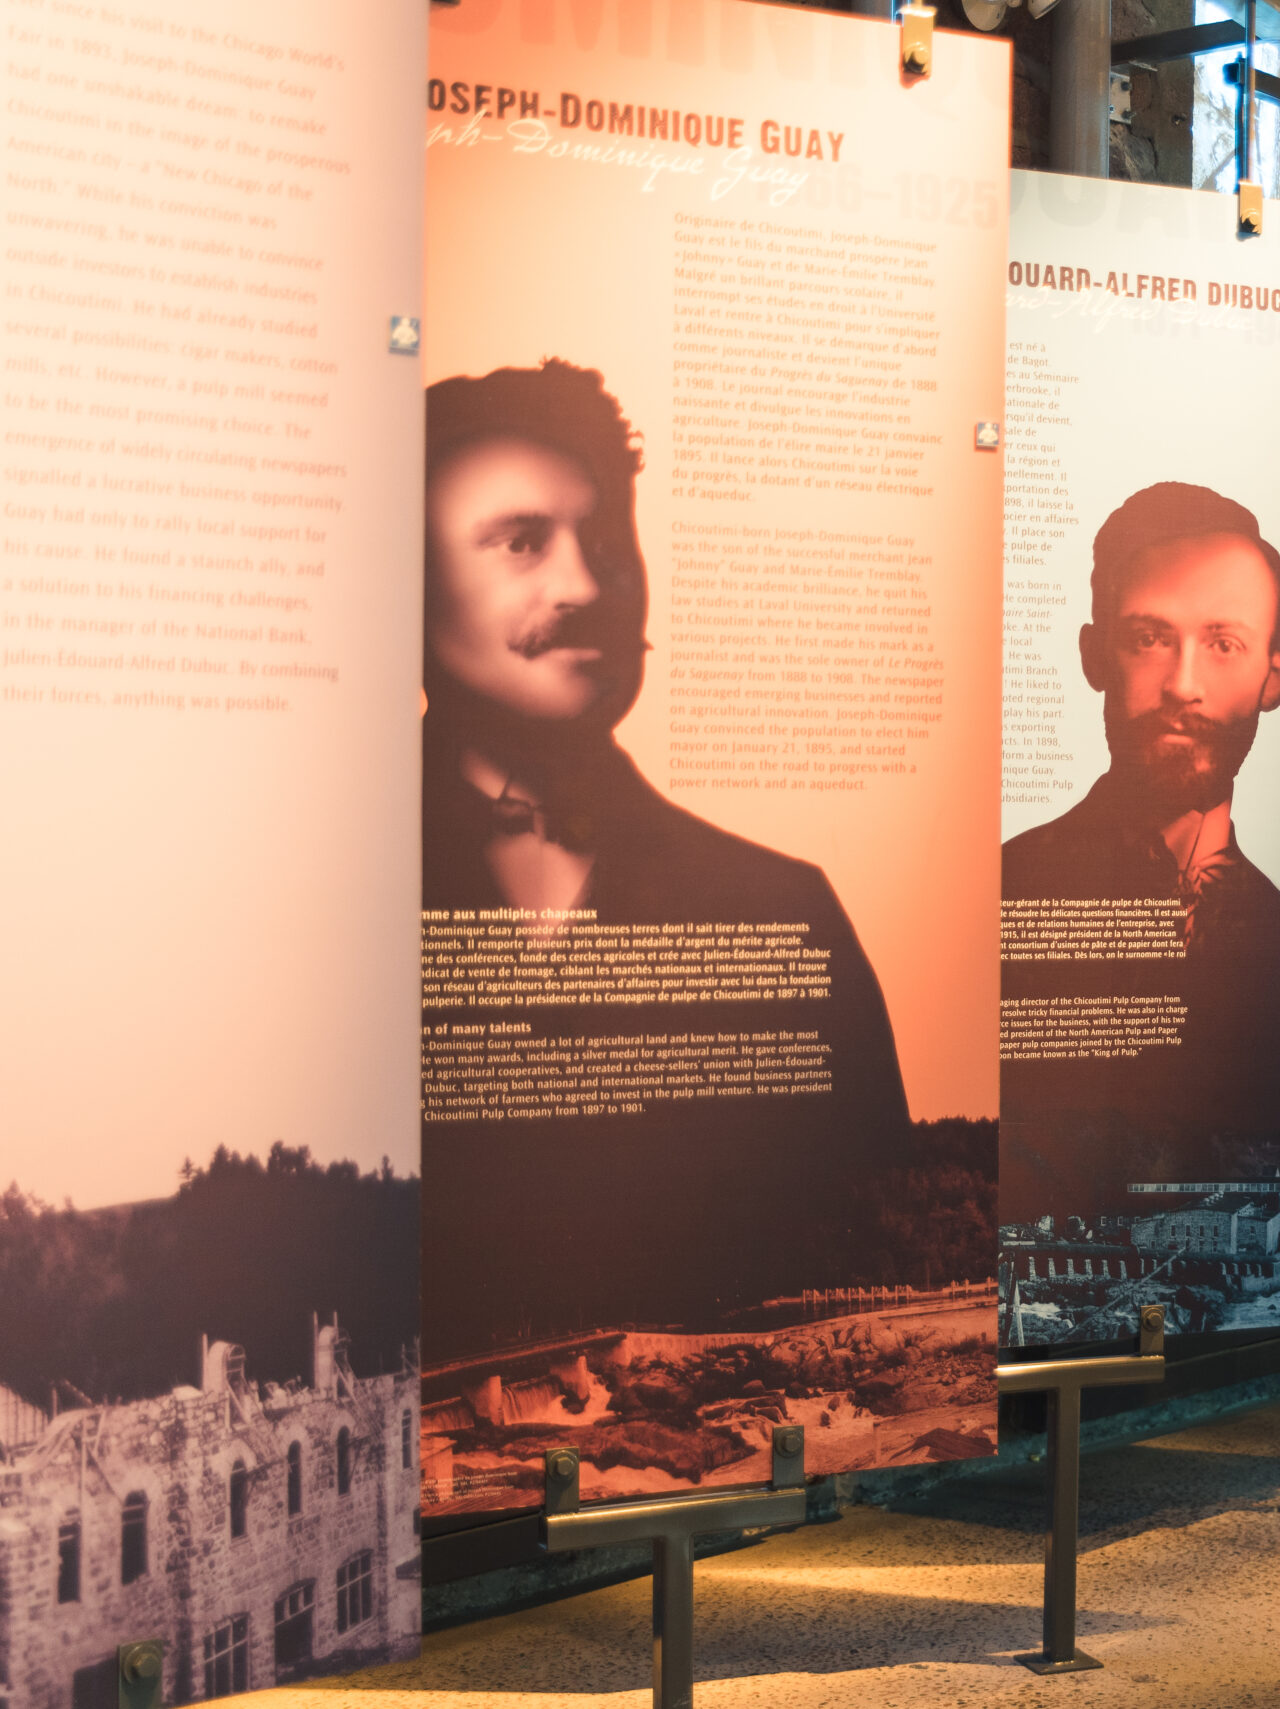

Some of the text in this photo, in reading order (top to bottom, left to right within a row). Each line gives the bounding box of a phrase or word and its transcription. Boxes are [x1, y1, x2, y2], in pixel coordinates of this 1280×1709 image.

[760, 119, 845, 163] GUAY
[1041, 898, 1051, 906] de
[1052, 898, 1059, 906] la
[1060, 898, 1100, 908] Compagnie
[1111, 898, 1132, 907] pulpe
[453, 910, 476, 919] aux
[478, 909, 536, 921] multiples
[541, 908, 597, 920] chapeaux
[468, 995, 476, 1005] Il
[477, 998, 512, 1007] occupe
[514, 994, 524, 1004] la
[525, 993, 577, 1006] présidence
[578, 993, 591, 1002] de
[593, 993, 603, 1002] la
[604, 991, 656, 1004] Compagnie
[657, 991, 670, 1000] de
[671, 990, 698, 1003] pulpe
[699, 990, 712, 999] de
[713, 989, 762, 999] Chicoutimi
[762, 989, 775, 998] de
[777, 988, 798, 998] 1897
[799, 988, 806, 997] à
[1020, 997, 1049, 1005] director
[1073, 996, 1112, 1004] Chicoutimi
[1112, 996, 1129, 1005] Pulp
[1130, 995, 1163, 1005] Company
[1163, 994, 1181, 1002] from
[487, 1038, 512, 1051] Guay
[514, 1037, 547, 1047] owned
[558, 1036, 572, 1046] lot
[574, 1036, 585, 1045] of
[587, 1034, 644, 1048] agricultural
[645, 1033, 668, 1043] land
[669, 1033, 689, 1042] and
[690, 1032, 715, 1042] knew
[717, 1031, 738, 1041] how
[739, 1031, 750, 1040] to
[751, 1030, 777, 1040] make
[778, 1029, 794, 1039] the
[796, 1029, 819, 1038] most
[424, 1109, 479, 1120] Chicoutimi
[481, 1108, 505, 1121] Pulp
[507, 1106, 553, 1120] Company
[555, 1105, 579, 1115] from
[582, 1104, 605, 1114] 1897
[607, 1103, 618, 1113] to
